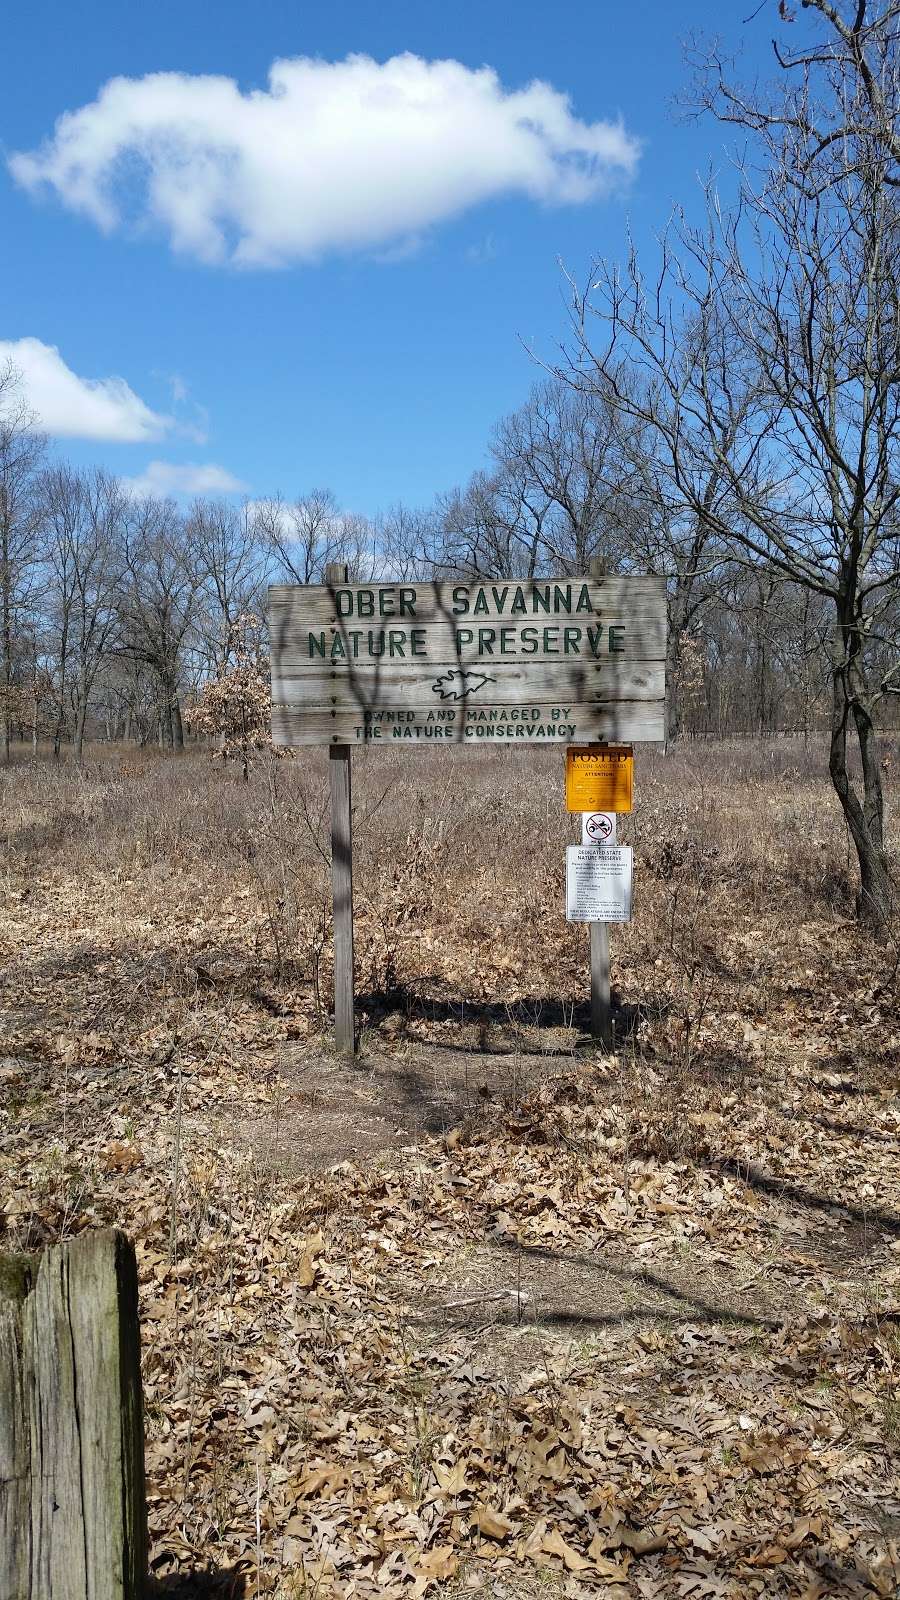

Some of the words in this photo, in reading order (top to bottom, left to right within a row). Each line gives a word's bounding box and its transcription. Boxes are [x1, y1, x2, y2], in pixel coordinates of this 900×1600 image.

[335, 587, 417, 618] OBER
[452, 583, 593, 615] SAVANNA
[308, 629, 428, 659] NATURE
[456, 625, 626, 657] PRESERVE
[364, 710, 416, 723] OWNED
[426, 710, 456, 722] AND
[467, 708, 541, 722] MANAGED
[551, 708, 572, 720] BY
[353, 726, 382, 738] THE
[392, 725, 454, 738] NATURE
[464, 724, 577, 737] CONSERVANCY
[572, 751, 628, 762] POSTED
